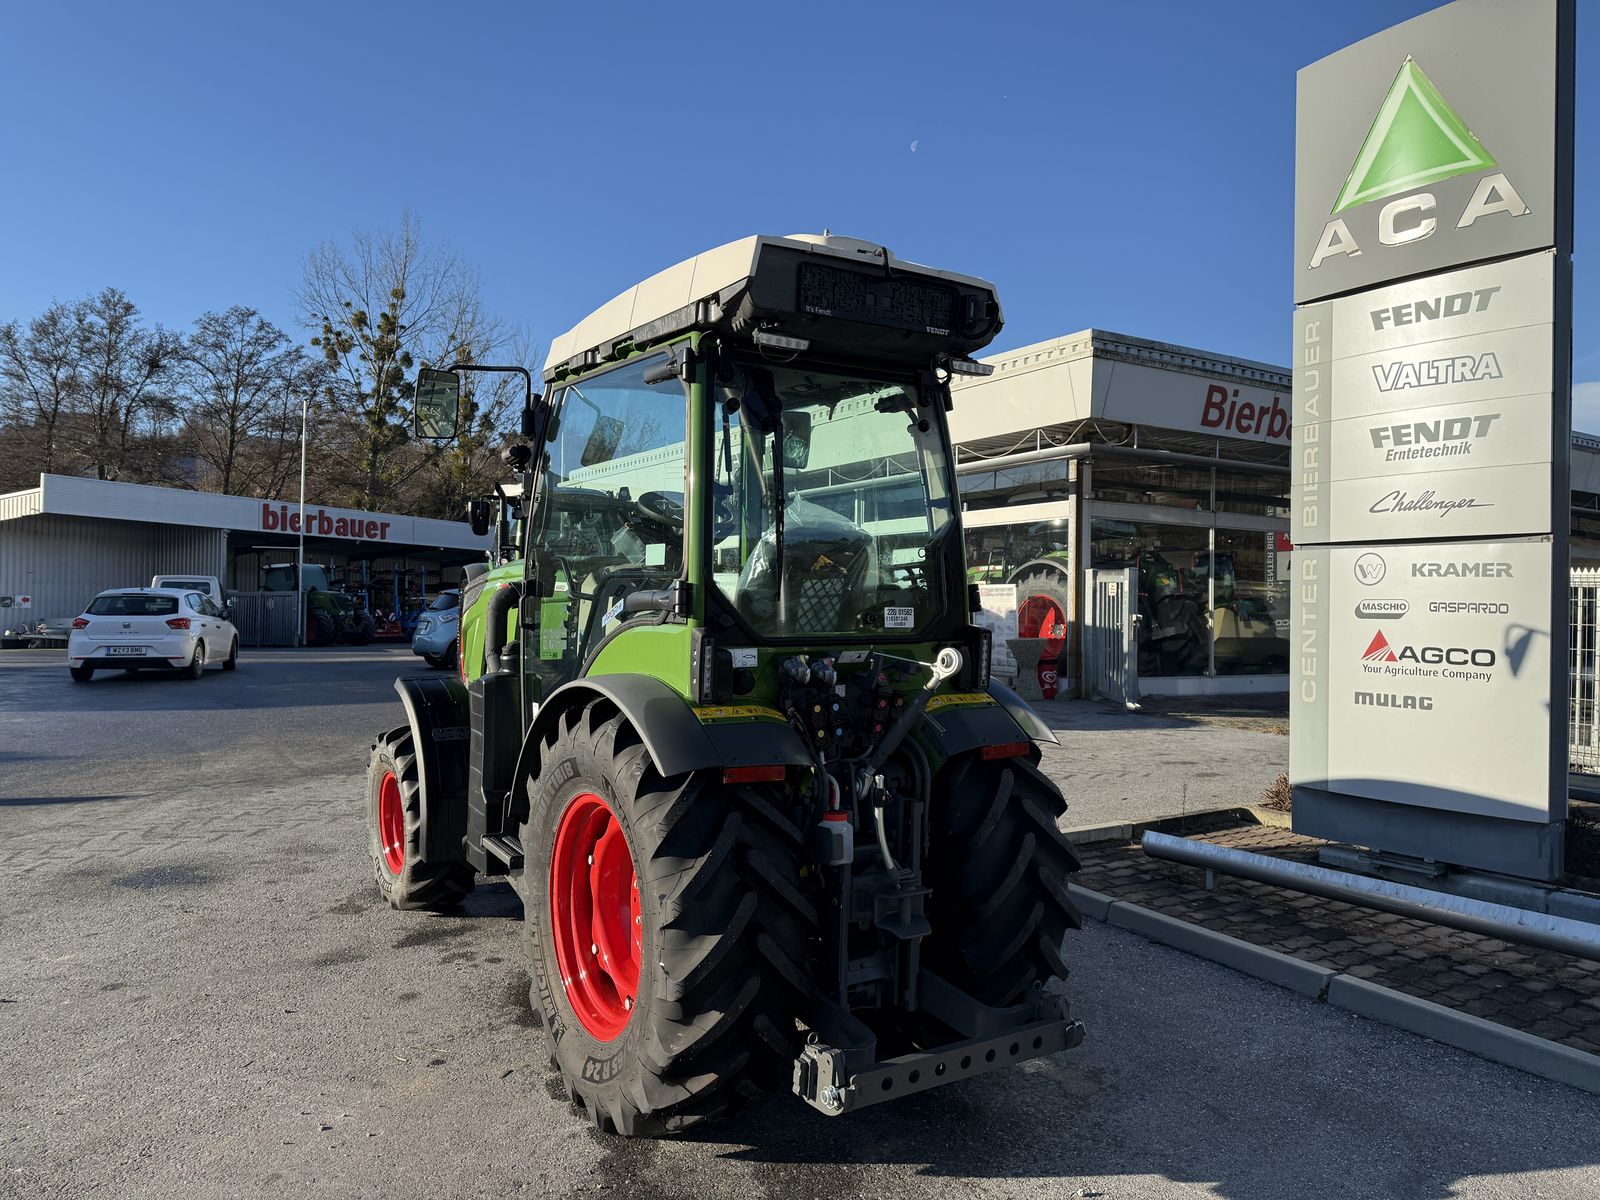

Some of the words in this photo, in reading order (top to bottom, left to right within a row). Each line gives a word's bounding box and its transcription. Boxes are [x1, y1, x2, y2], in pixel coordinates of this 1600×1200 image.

[1307, 172, 1532, 270] ACA
[1370, 286, 1502, 331] FENDT
[926, 325, 950, 336] FENDT
[1372, 352, 1503, 392] VALTRA
[1201, 384, 1292, 440] Bierb
[1301, 319, 1321, 529] BIERBAUER
[1369, 413, 1501, 449] FENDT
[1385, 441, 1472, 462] Erntetechnik
[1369, 490, 1495, 518] Challenger
[262, 503, 390, 540] bierbauer
[1411, 562, 1515, 578] KRAMER
[1361, 602, 1407, 613] MASCHIO
[1428, 601, 1509, 615] GASPARDO
[1301, 558, 1318, 703] CENTER
[1398, 645, 1496, 667] AGCO
[1362, 663, 1382, 675] Your
[1384, 665, 1439, 678] Agriculture
[1442, 668, 1493, 683] Company
